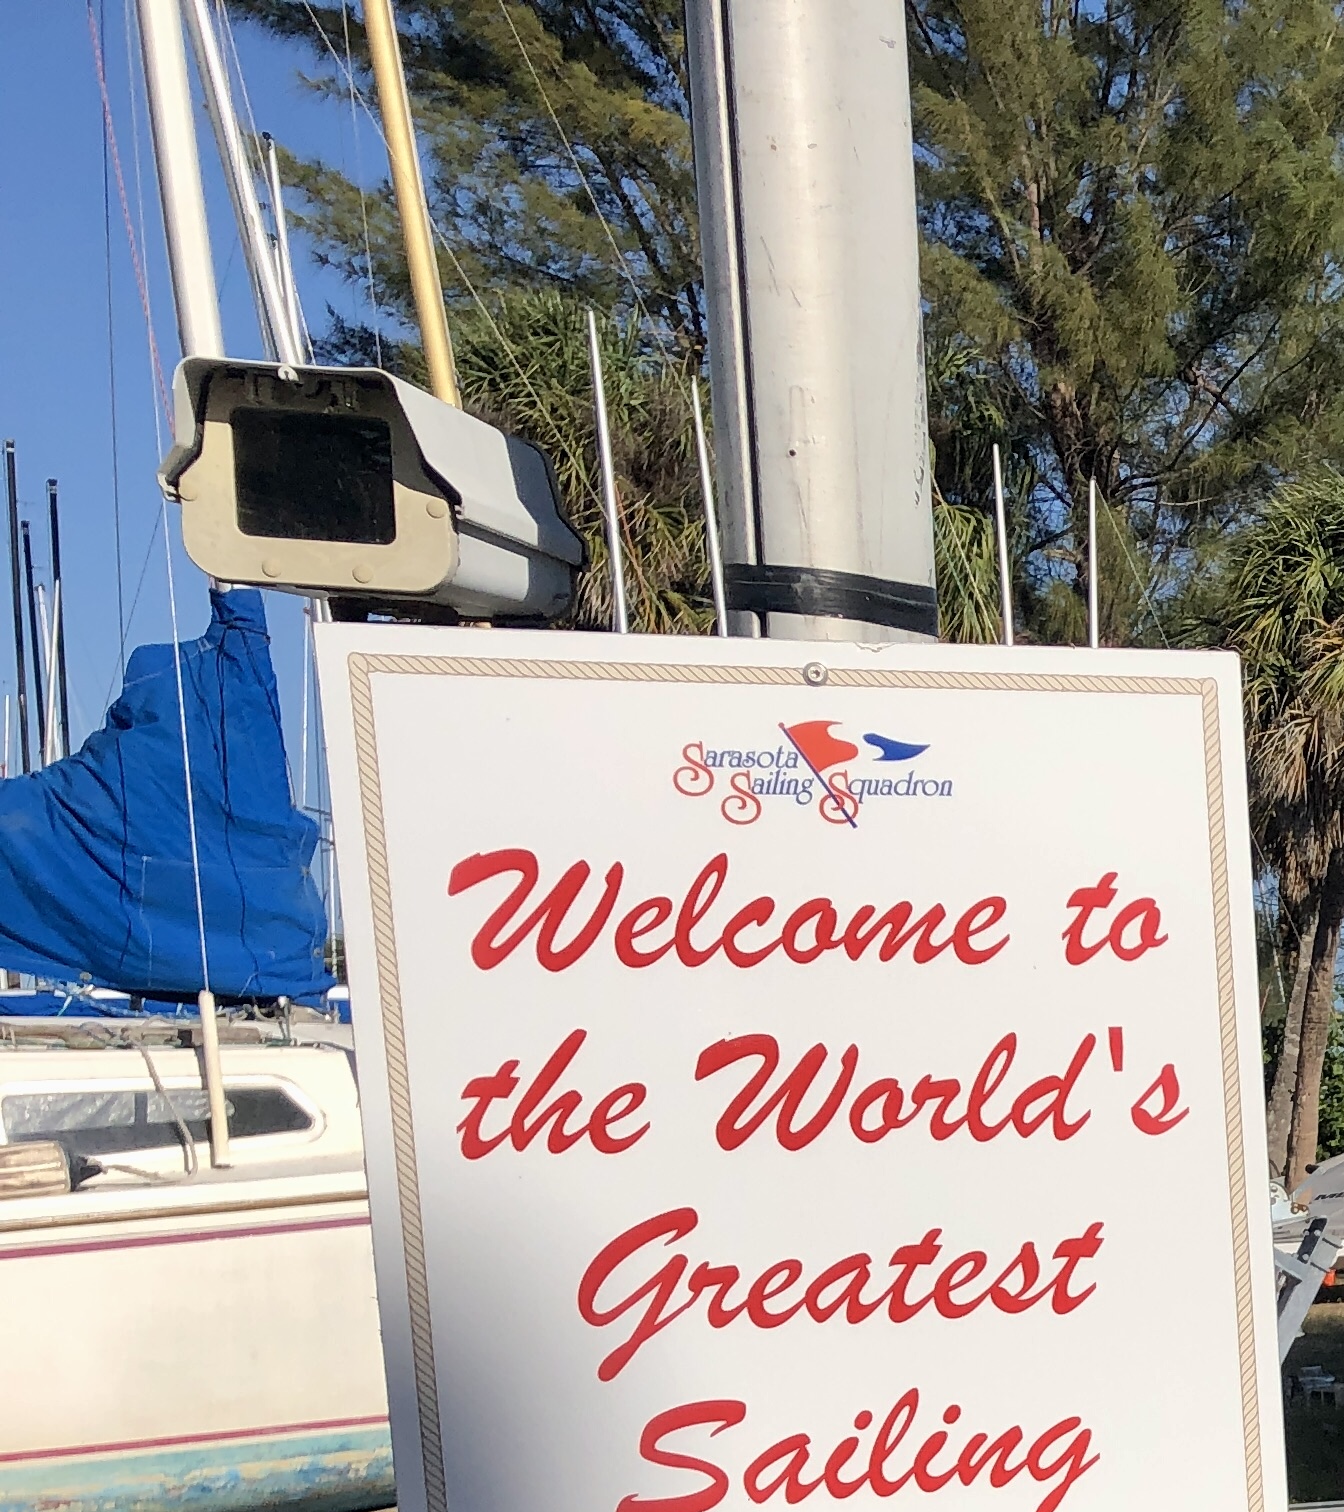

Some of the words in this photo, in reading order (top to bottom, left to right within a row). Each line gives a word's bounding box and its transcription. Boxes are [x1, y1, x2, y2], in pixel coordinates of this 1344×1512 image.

[672, 740, 799, 797] Sarasota
[720, 769, 814, 825] Sailing
[819, 769, 953, 825] Squadron
[448, 849, 1009, 973] Welcome
[1062, 872, 1168, 966] to
[457, 1029, 650, 1160] the
[694, 1027, 1188, 1152] World's
[577, 1207, 1104, 1382] Greatest
